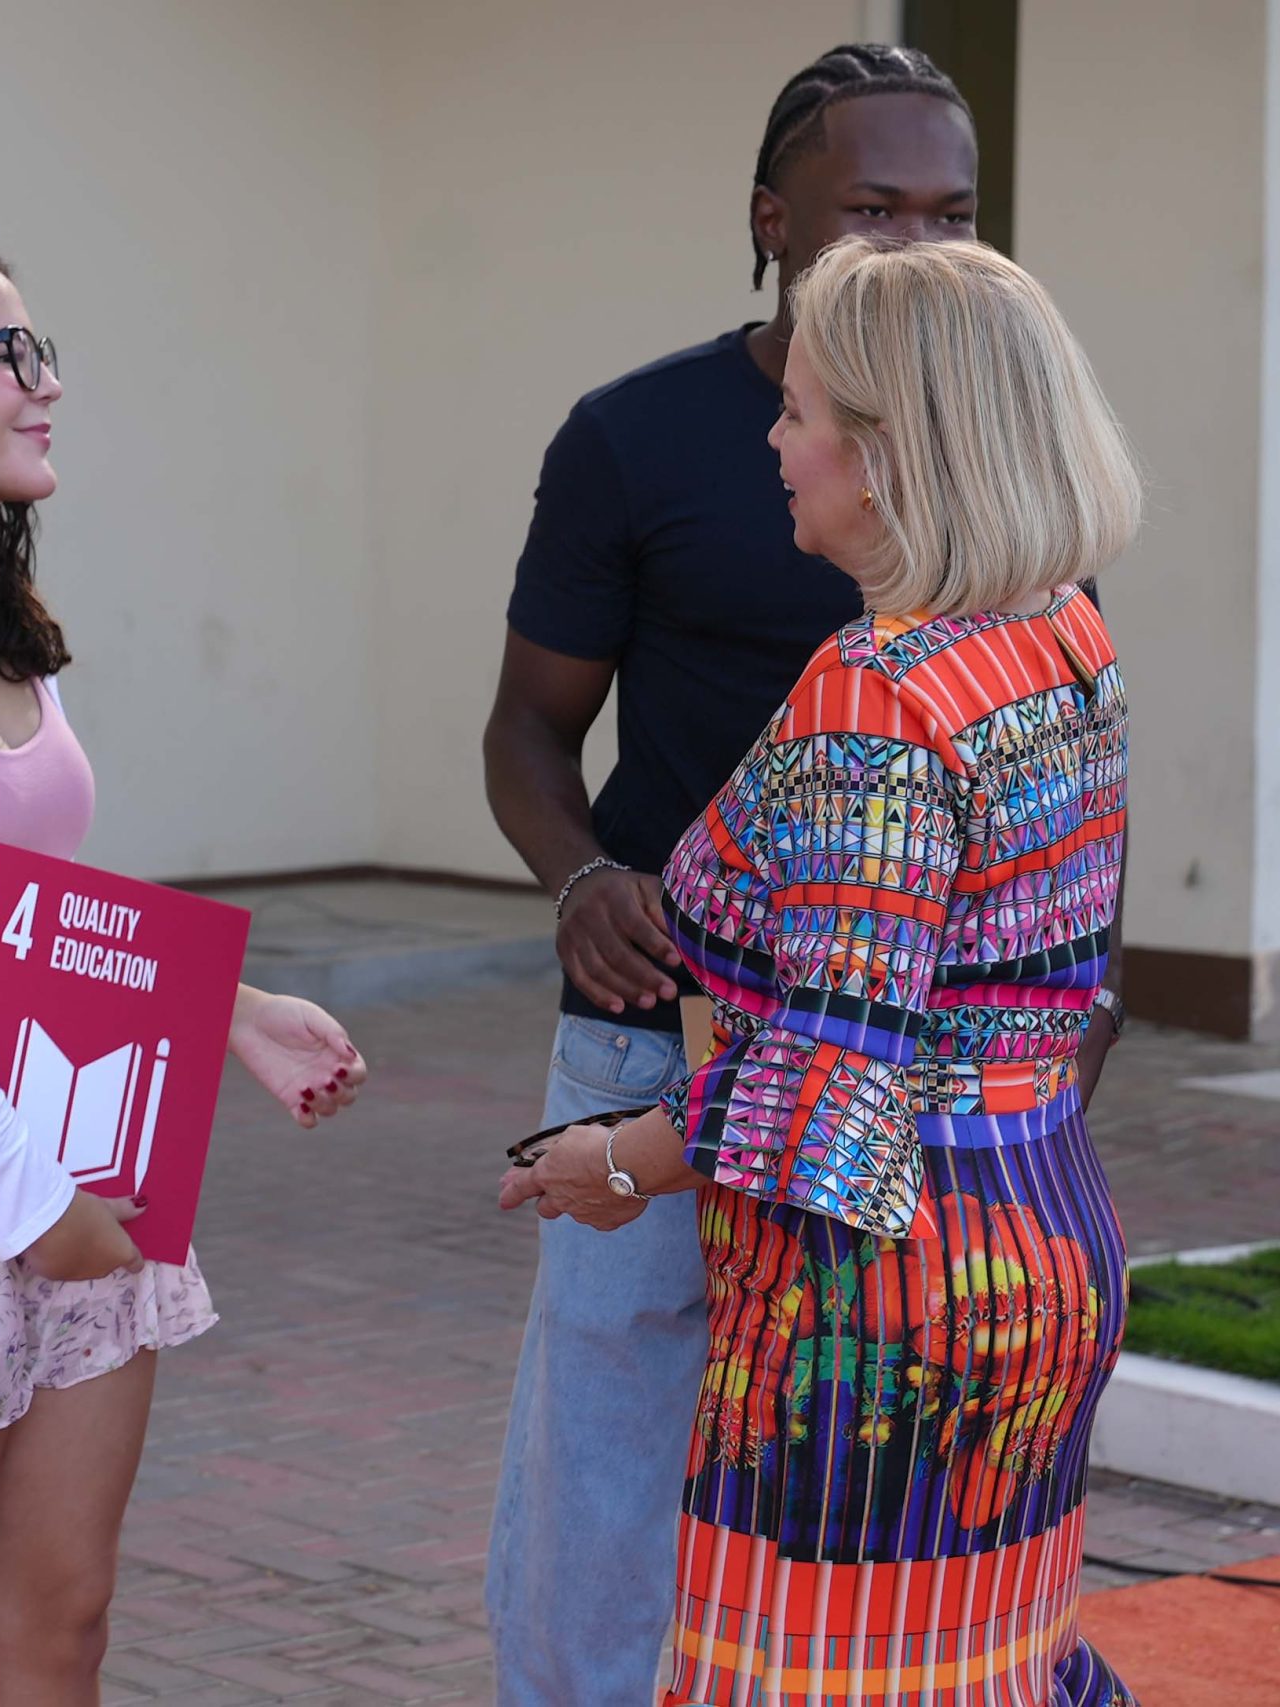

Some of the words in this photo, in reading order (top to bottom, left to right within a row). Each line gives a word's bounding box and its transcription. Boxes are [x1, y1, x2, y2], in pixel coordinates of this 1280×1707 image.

[1, 881, 40, 961] 4
[58, 891, 141, 942] QUALITY
[49, 935, 158, 992] EDUCATION
